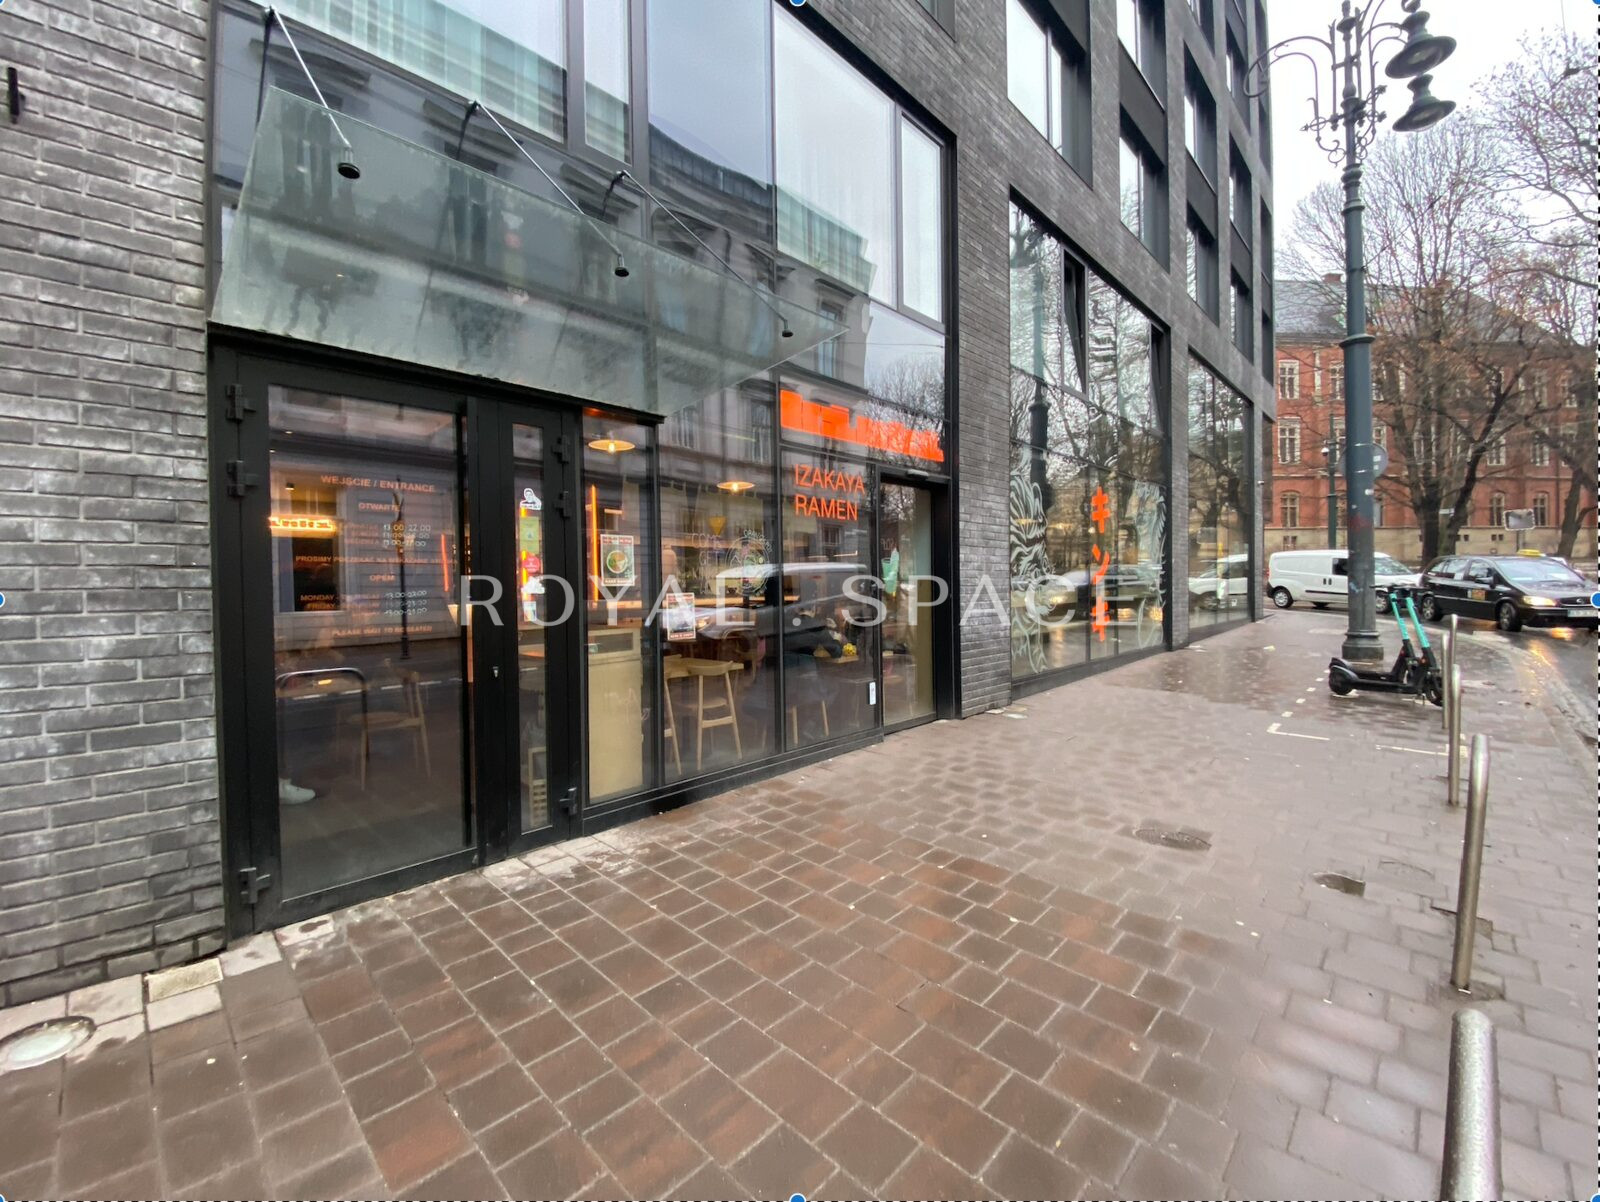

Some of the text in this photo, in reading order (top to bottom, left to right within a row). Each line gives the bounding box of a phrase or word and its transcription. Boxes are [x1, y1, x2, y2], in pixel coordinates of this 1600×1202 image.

[380, 480, 435, 493] ENTRANCE
[794, 463, 865, 495] IZAKAYA
[795, 495, 858, 521] RAMEN
[295, 555, 332, 563] PROSIMY
